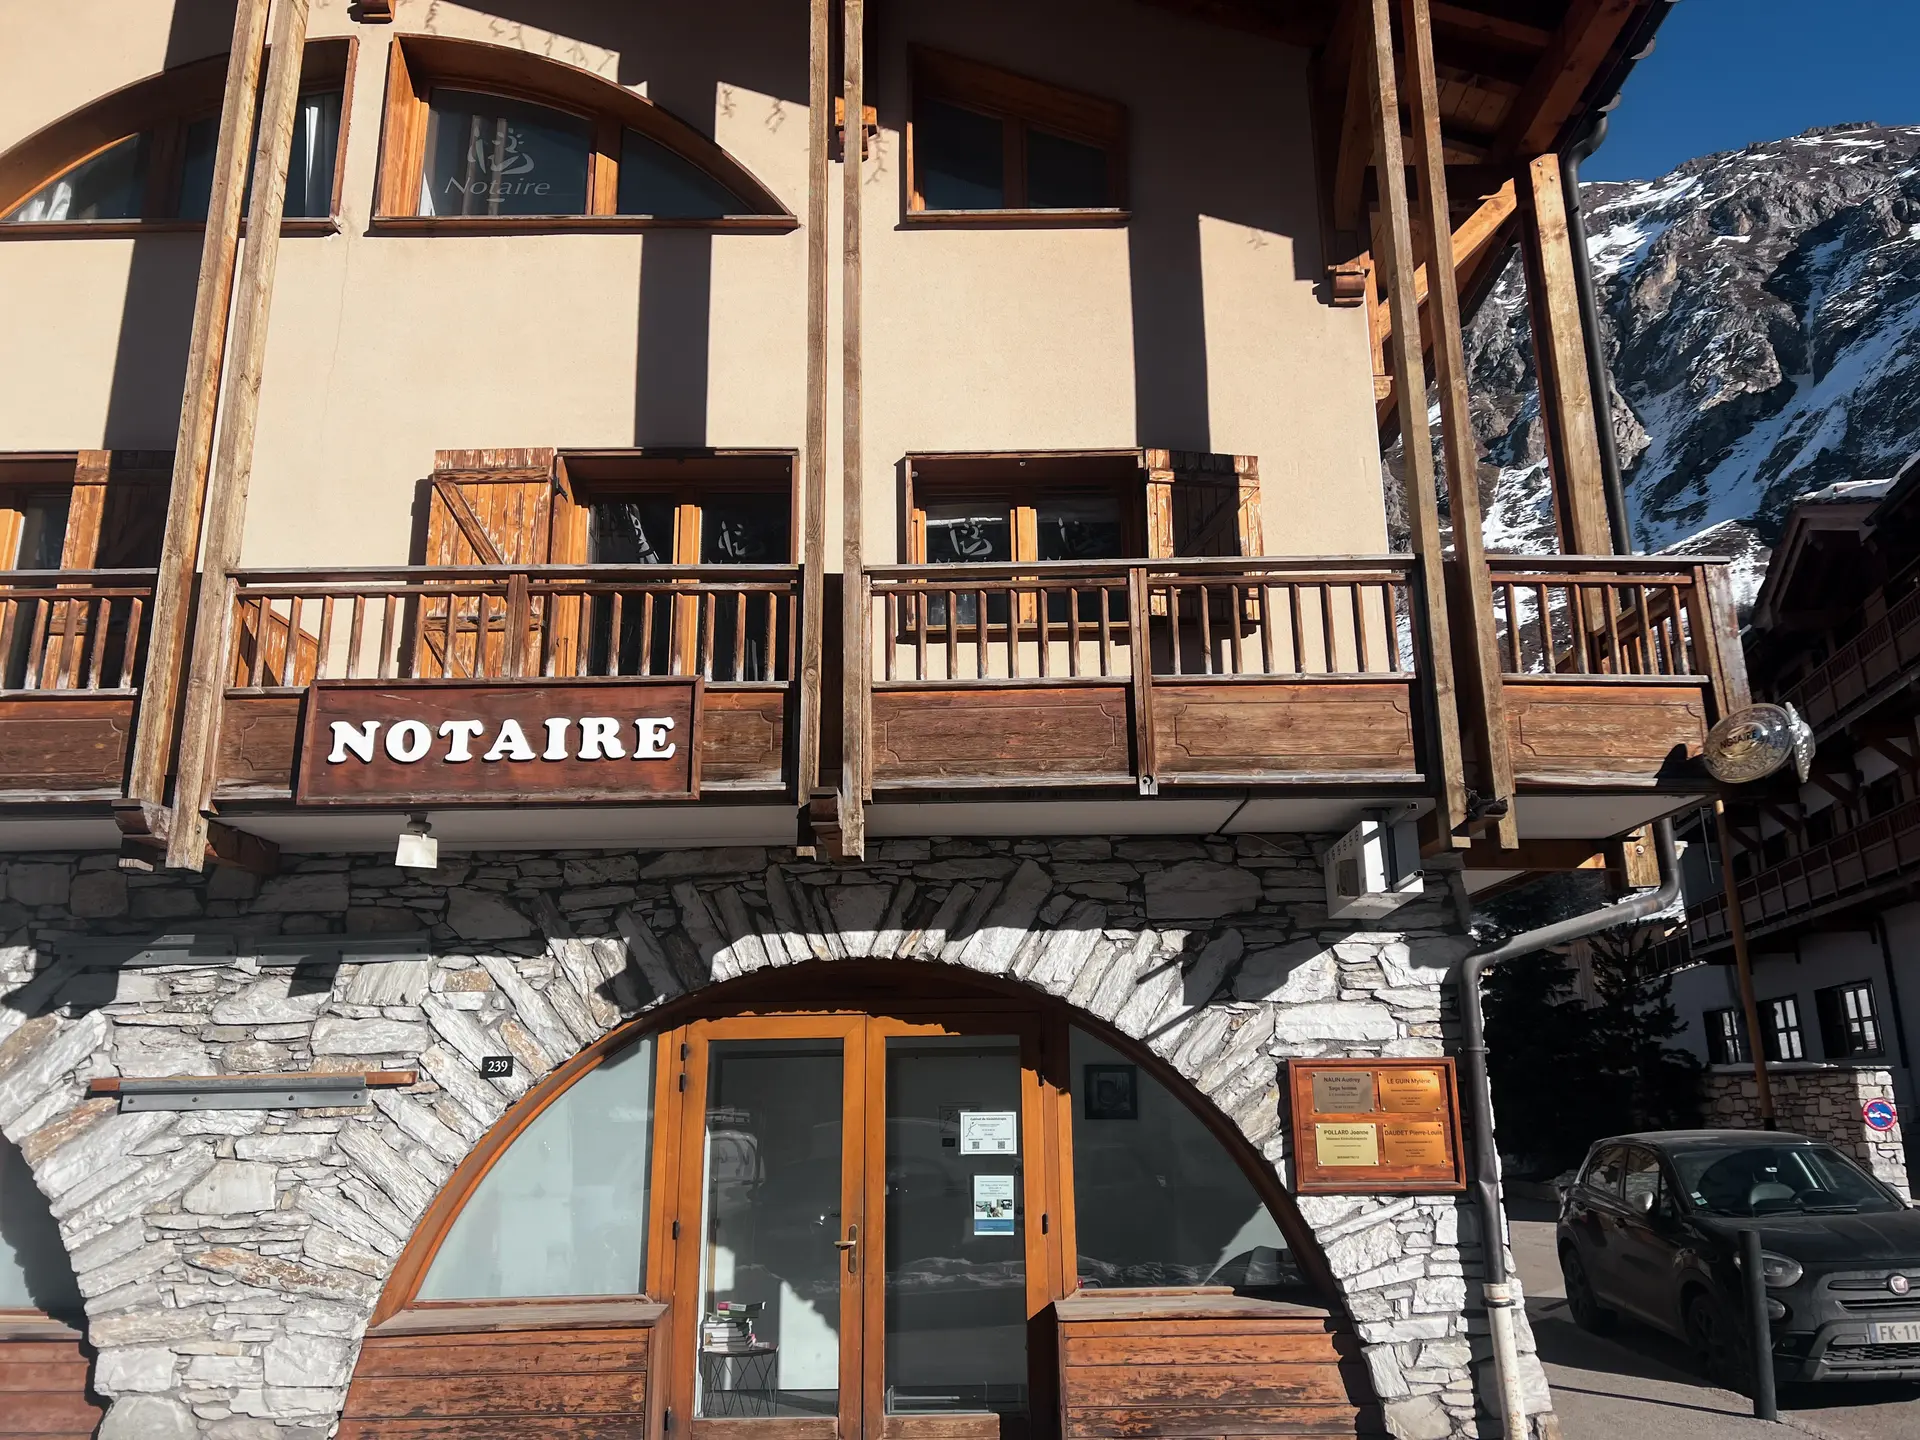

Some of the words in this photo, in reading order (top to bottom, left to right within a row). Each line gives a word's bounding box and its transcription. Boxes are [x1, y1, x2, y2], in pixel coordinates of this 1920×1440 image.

[444, 176, 551, 196] Notaire
[326, 716, 677, 764] NOTAIRE
[487, 1060, 509, 1073] 239
[1879, 1323, 1920, 1342] FK-11
